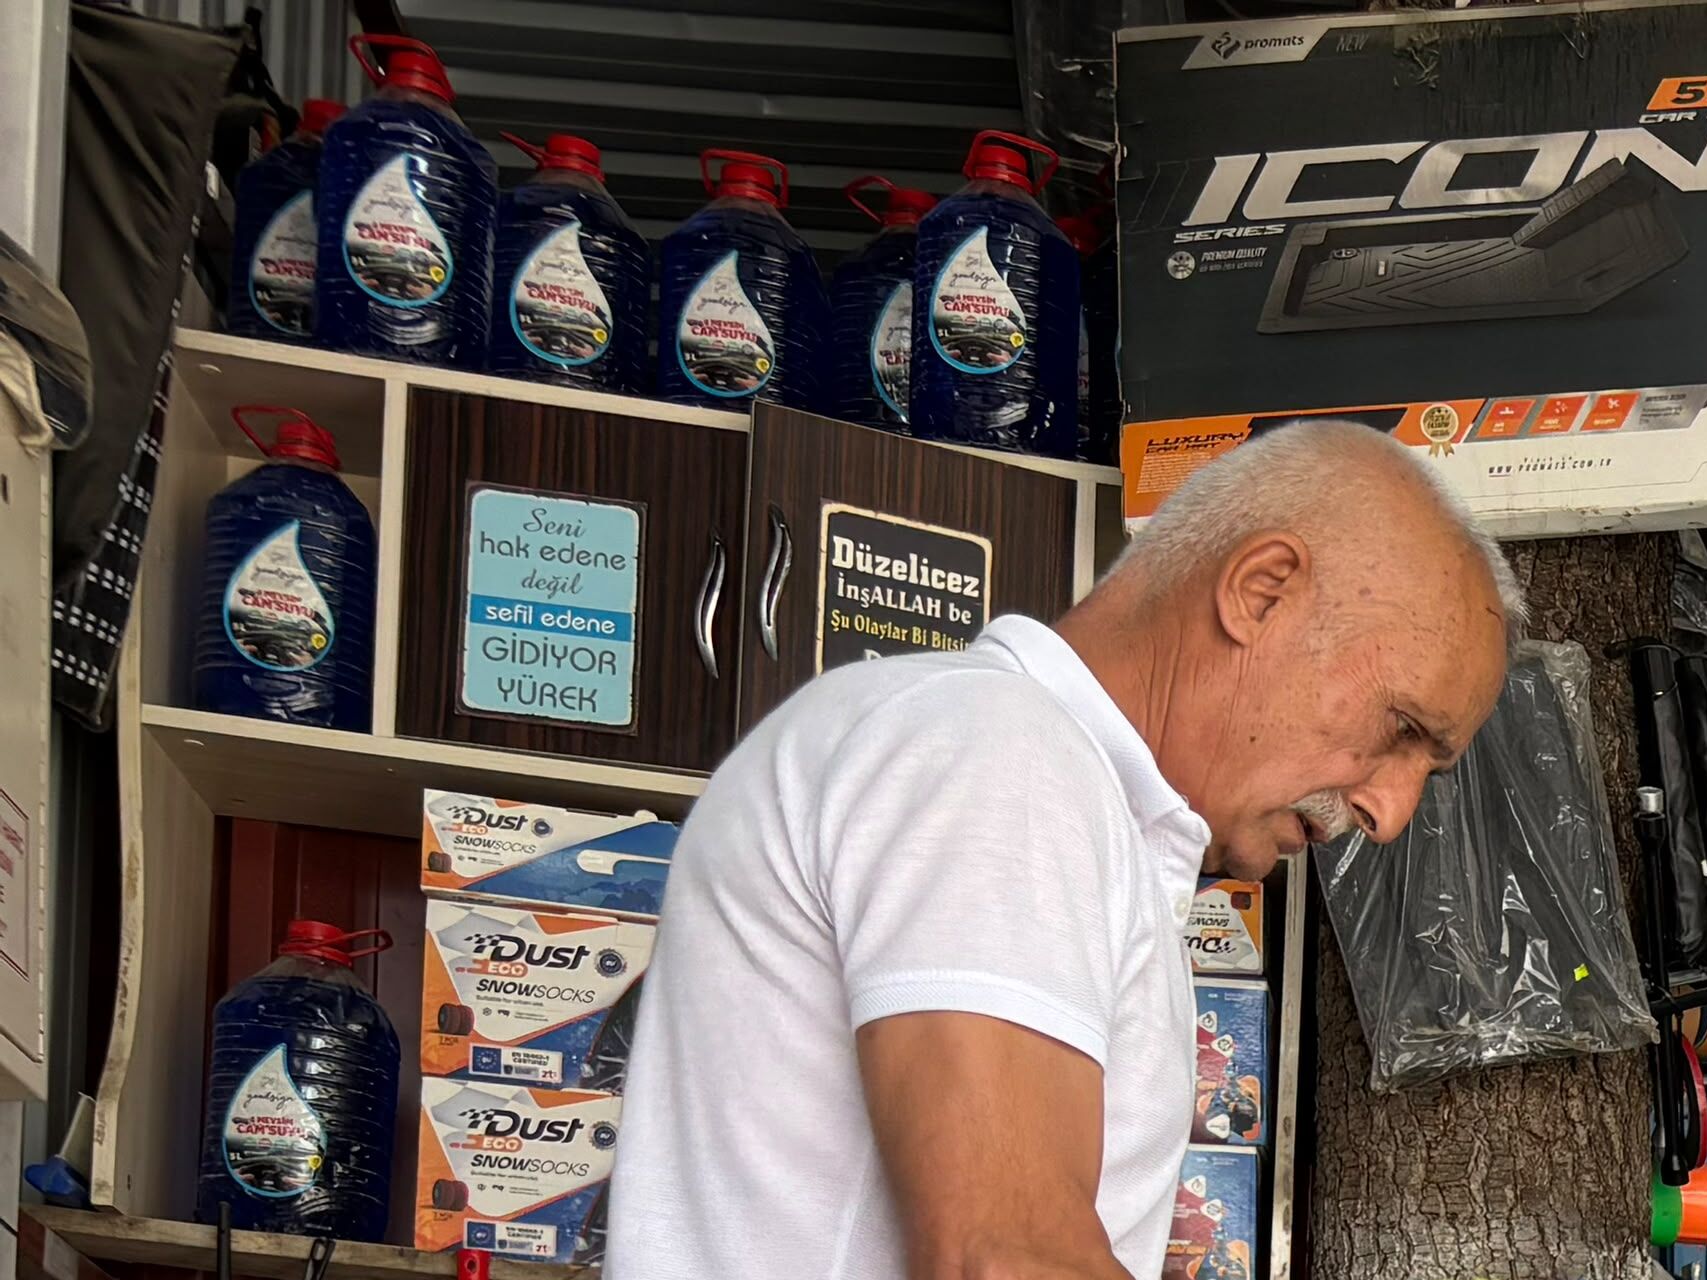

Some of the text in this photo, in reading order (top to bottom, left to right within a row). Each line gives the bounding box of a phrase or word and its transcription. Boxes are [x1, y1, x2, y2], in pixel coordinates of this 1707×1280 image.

[1244, 34, 1305, 52] promats
[1638, 111, 1701, 125] CAR
[1173, 223, 1287, 244] SERIES
[522, 507, 585, 538] Seni
[480, 531, 627, 571] hak edene
[832, 535, 981, 599] Düzelicez
[521, 571, 583, 595] değil
[837, 571, 973, 625] İnşALLAH be
[486, 604, 616, 634] sefil edene
[831, 608, 851, 633] Şu
[853, 613, 909, 642] Olaylar
[911, 626, 928, 646] Bi
[482, 633, 617, 676] GİDİYOR
[497, 675, 598, 713] YÜREK
[487, 960, 526, 977] ECO
[476, 977, 596, 1005] SNOWSOCKS
[482, 1135, 524, 1152] ECO
[470, 1152, 590, 1178] SNOWSOCKS
